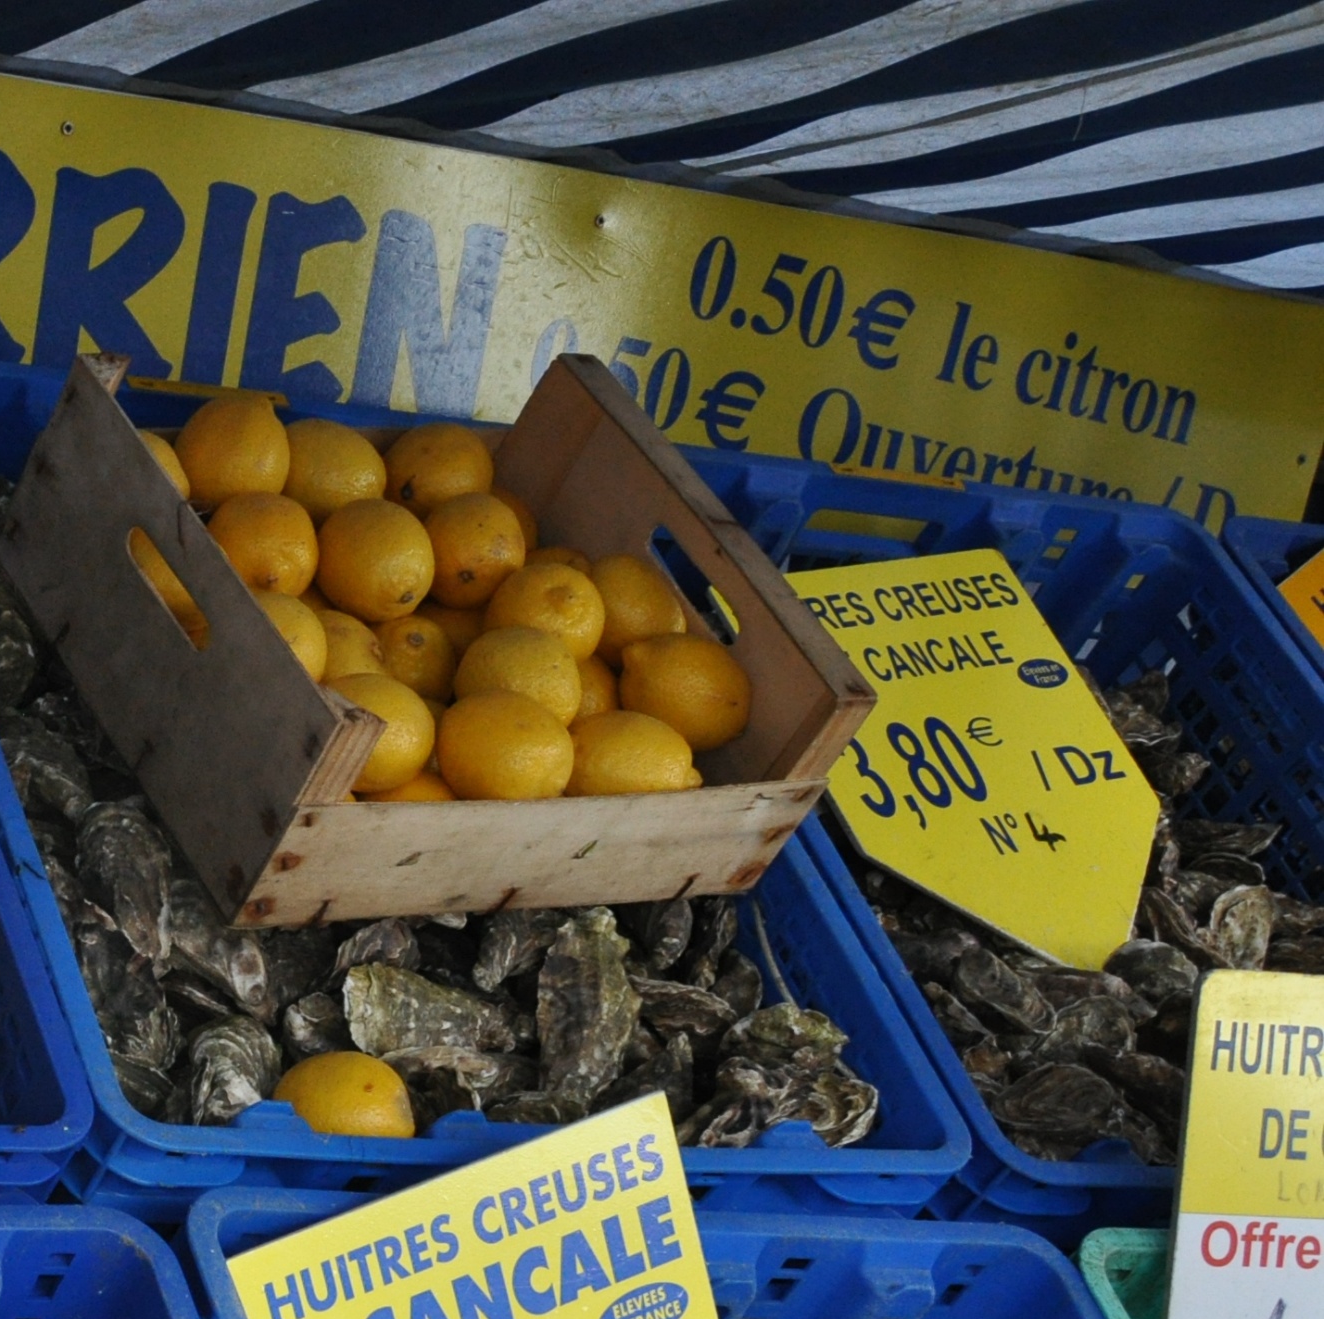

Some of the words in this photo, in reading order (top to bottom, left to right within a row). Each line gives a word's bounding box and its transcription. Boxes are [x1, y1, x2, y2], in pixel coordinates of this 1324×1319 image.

[689, 235, 916, 370] 0.50€
[936, 302, 1000, 390] le
[1014, 331, 1198, 446] citron
[874, 573, 1019, 621] CREUSES
[863, 630, 1014, 681] CANCALE
[1259, 1108, 1310, 1160] DE
[472, 1134, 663, 1244] CREUSES
[1201, 1220, 1321, 1269] Offre
[612, 1286, 666, 1319] ELEVEES
